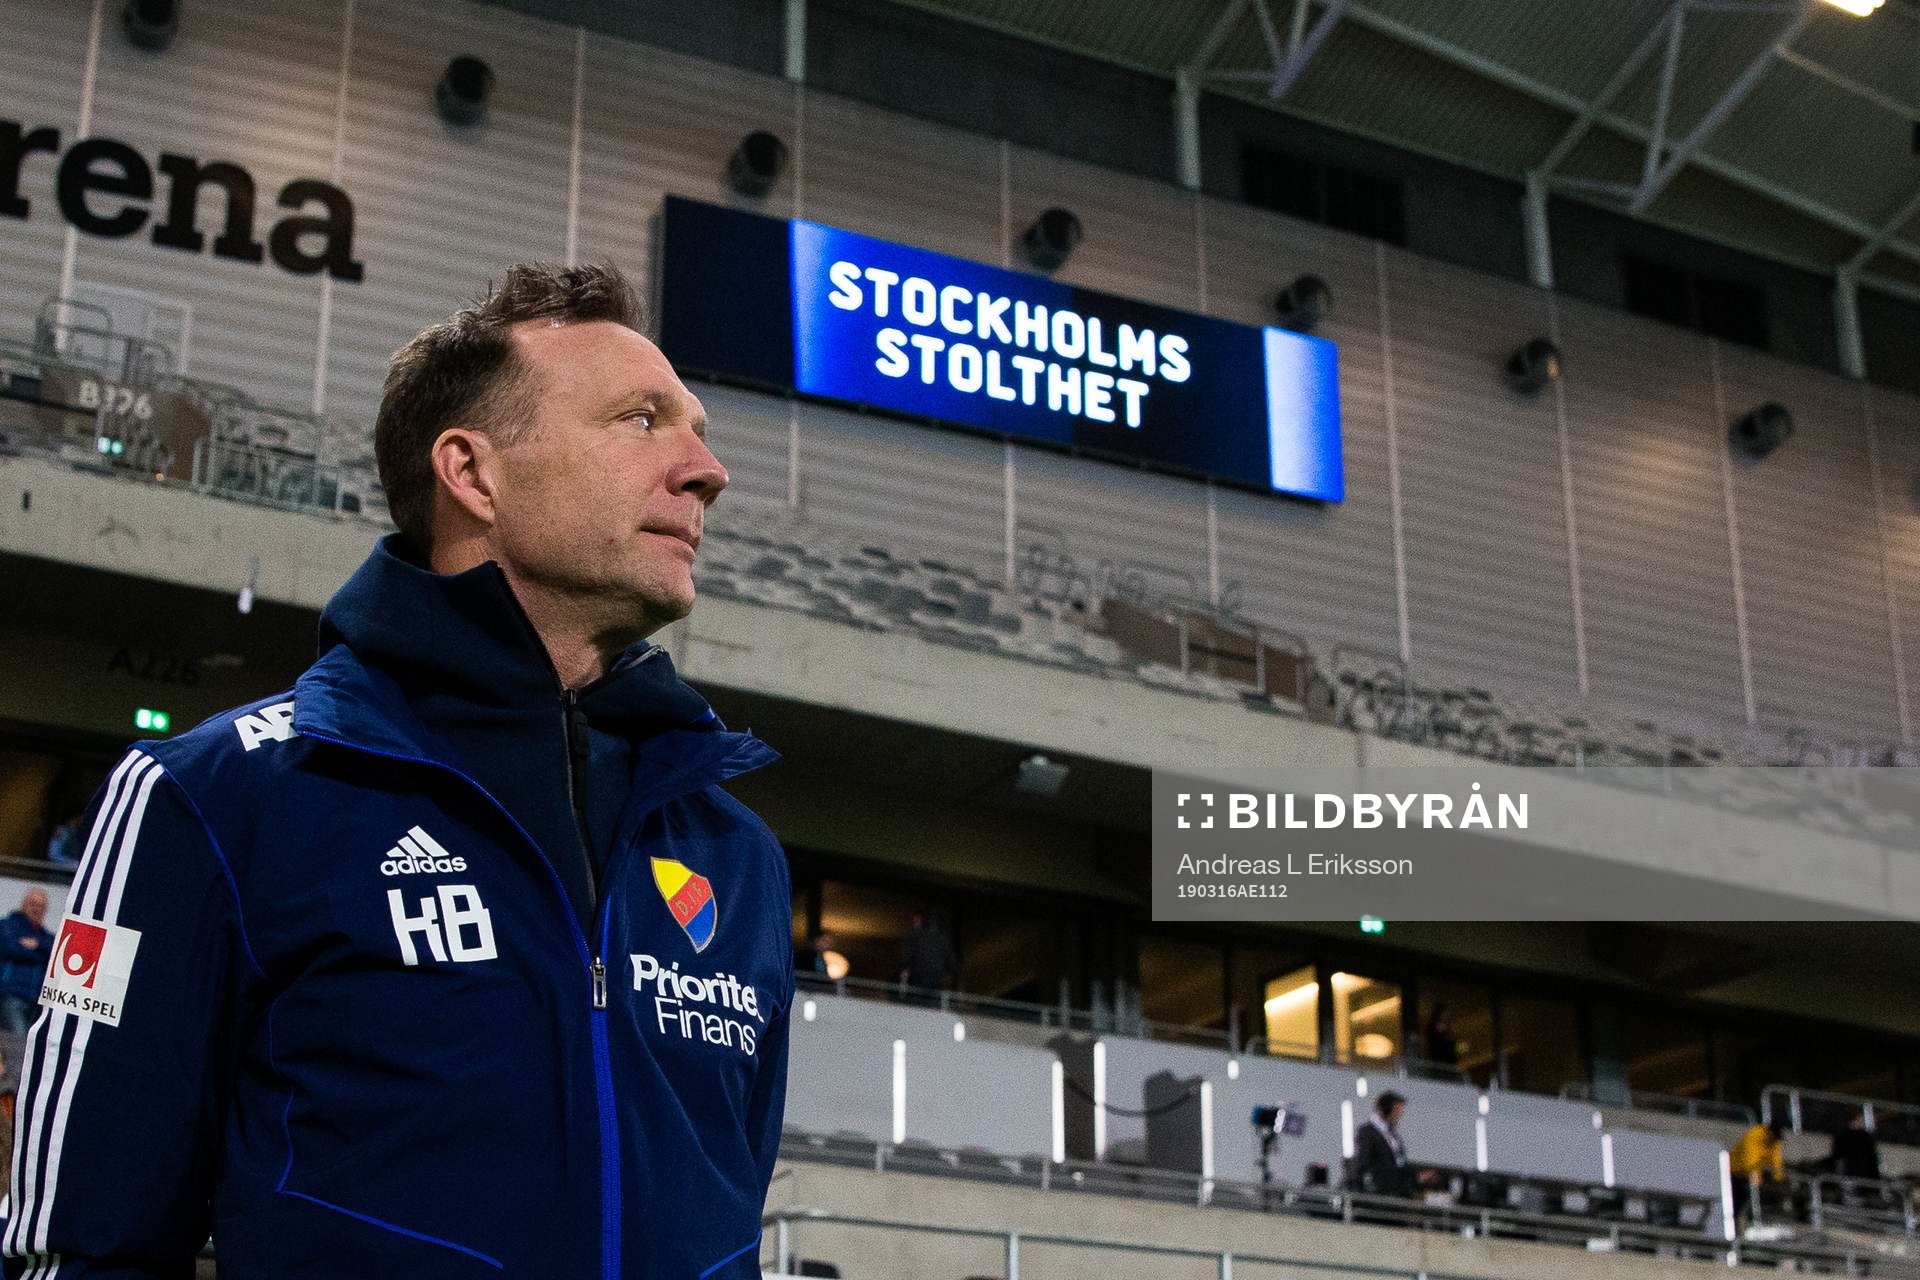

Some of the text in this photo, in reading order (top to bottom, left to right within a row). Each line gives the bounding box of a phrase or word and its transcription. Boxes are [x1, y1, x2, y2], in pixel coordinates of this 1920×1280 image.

[0, 118, 364, 284] rena
[828, 259, 1191, 384] STOCKHOLMS
[875, 327, 1150, 429] STOLTHET
[380, 855, 468, 876] adidas
[82, 997, 116, 1019] SPEL
[629, 953, 765, 1023] Priorite
[654, 996, 756, 1056] Finans
